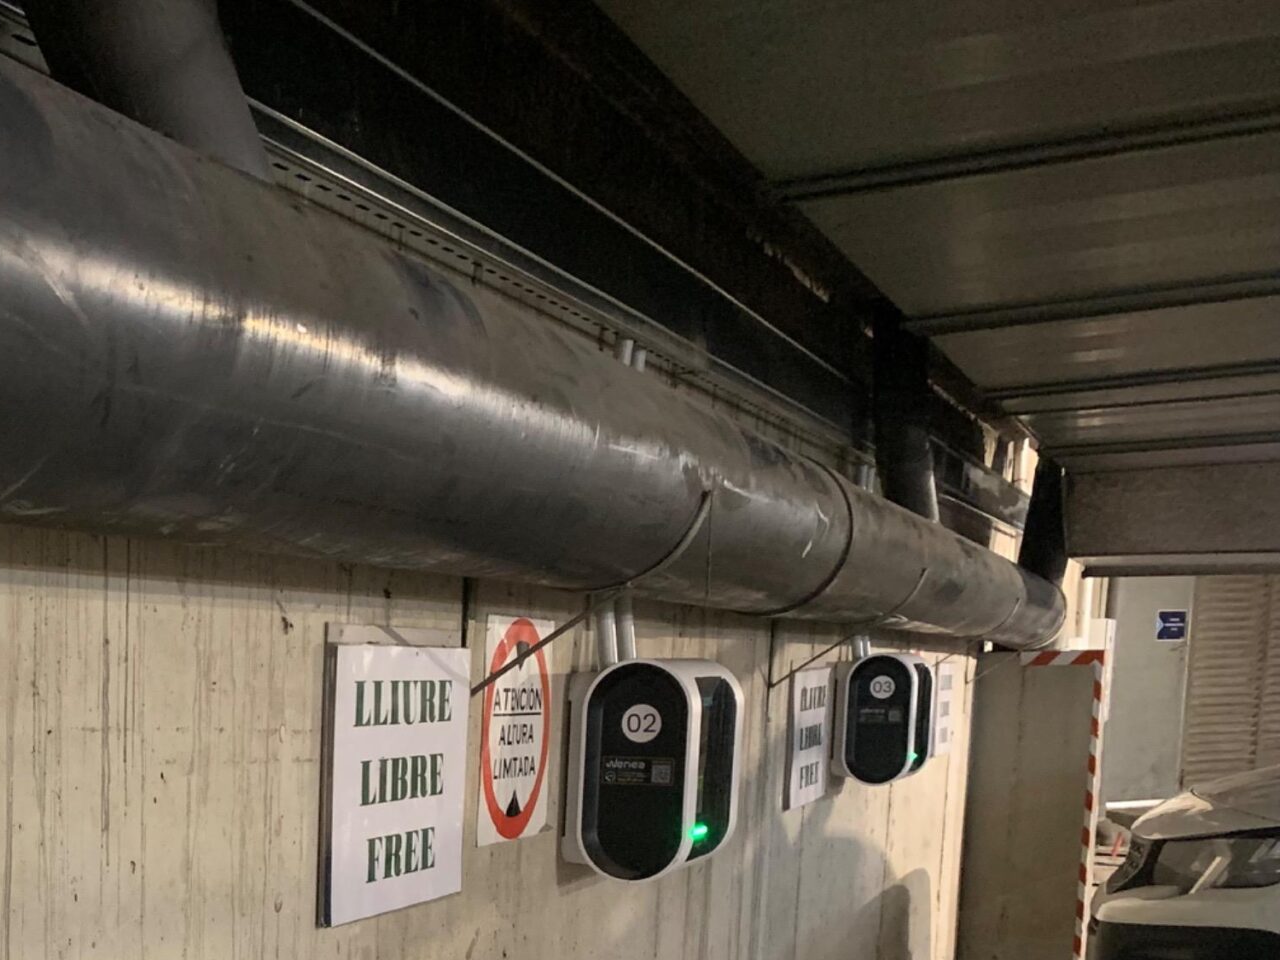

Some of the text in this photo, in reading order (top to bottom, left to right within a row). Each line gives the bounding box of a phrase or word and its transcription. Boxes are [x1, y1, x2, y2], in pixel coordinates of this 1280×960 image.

[872, 681, 894, 694] 03
[353, 680, 452, 727] LLIURE
[499, 723, 535, 746] ALTURA
[627, 713, 657, 733] 02
[365, 827, 435, 884] FREE
